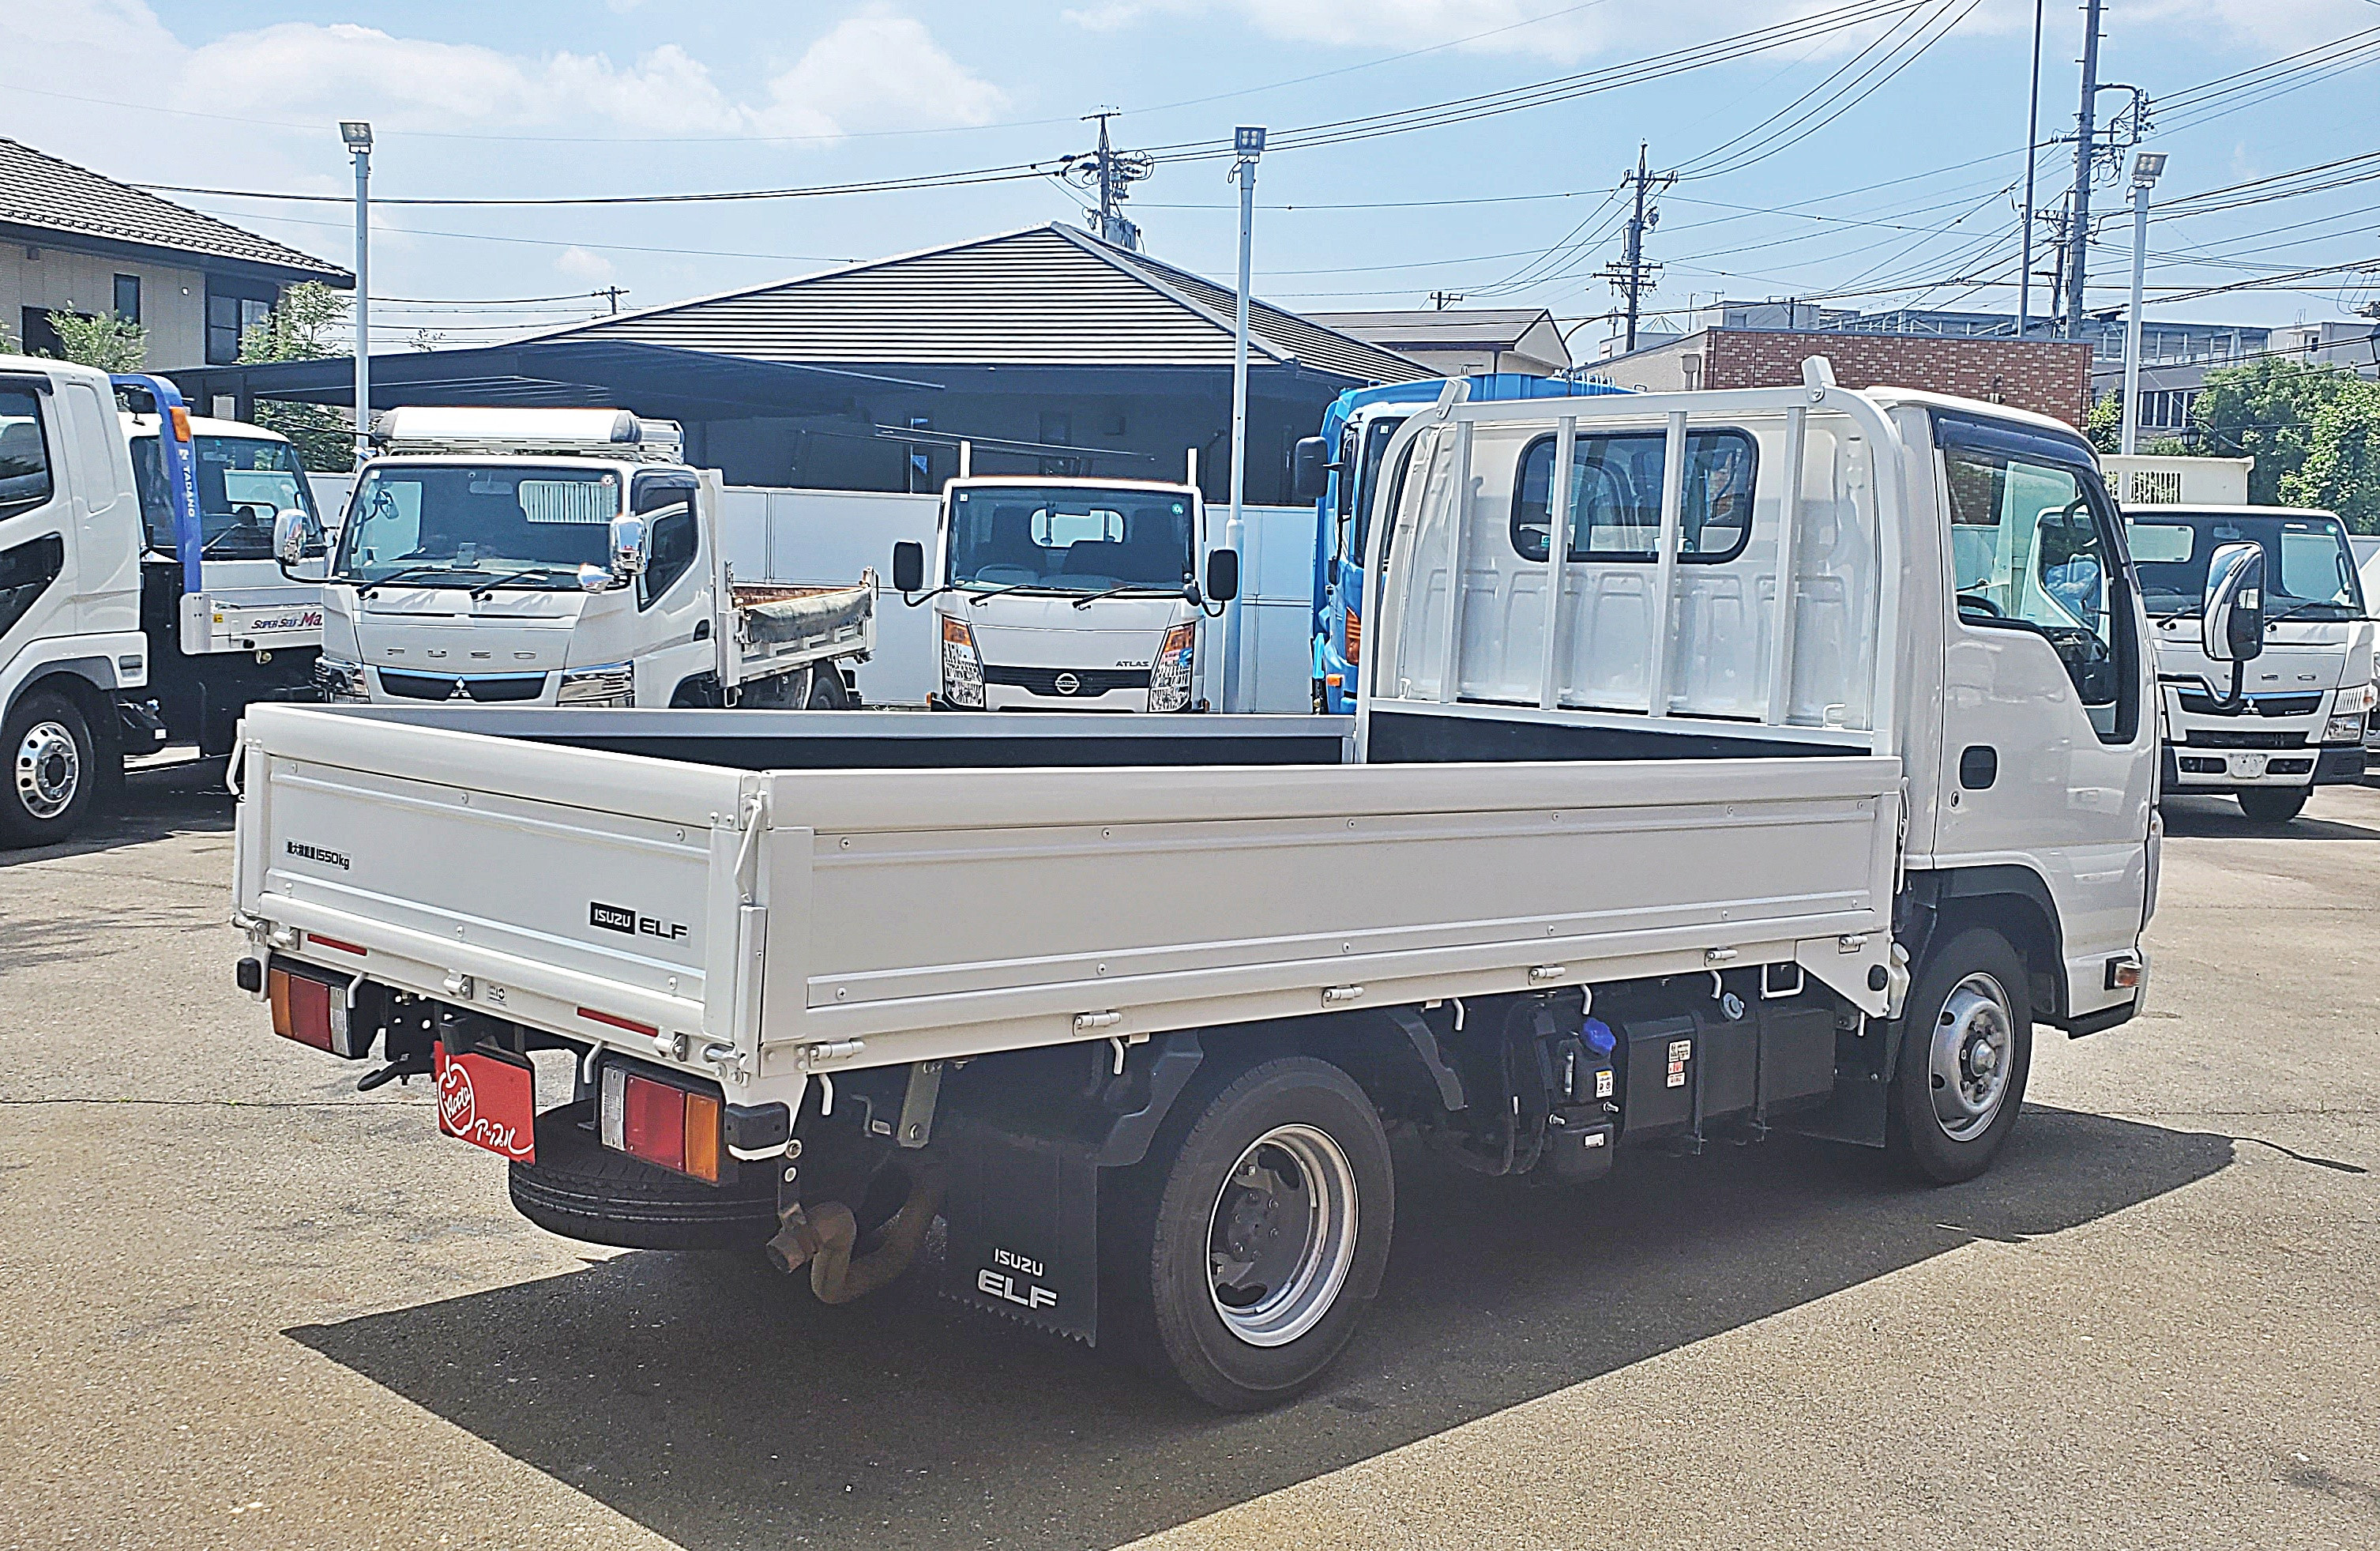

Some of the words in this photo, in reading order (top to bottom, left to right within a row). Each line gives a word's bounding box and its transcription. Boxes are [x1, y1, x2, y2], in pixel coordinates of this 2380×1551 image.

[183, 465, 195, 518] TADANO
[299, 612, 322, 627] Ma
[386, 646, 536, 660] FUSO
[595, 909, 631, 928] ISUZU
[639, 917, 688, 940] ELF
[994, 1248, 1043, 1277] ISUZU
[977, 1269, 1058, 1309] ELF
